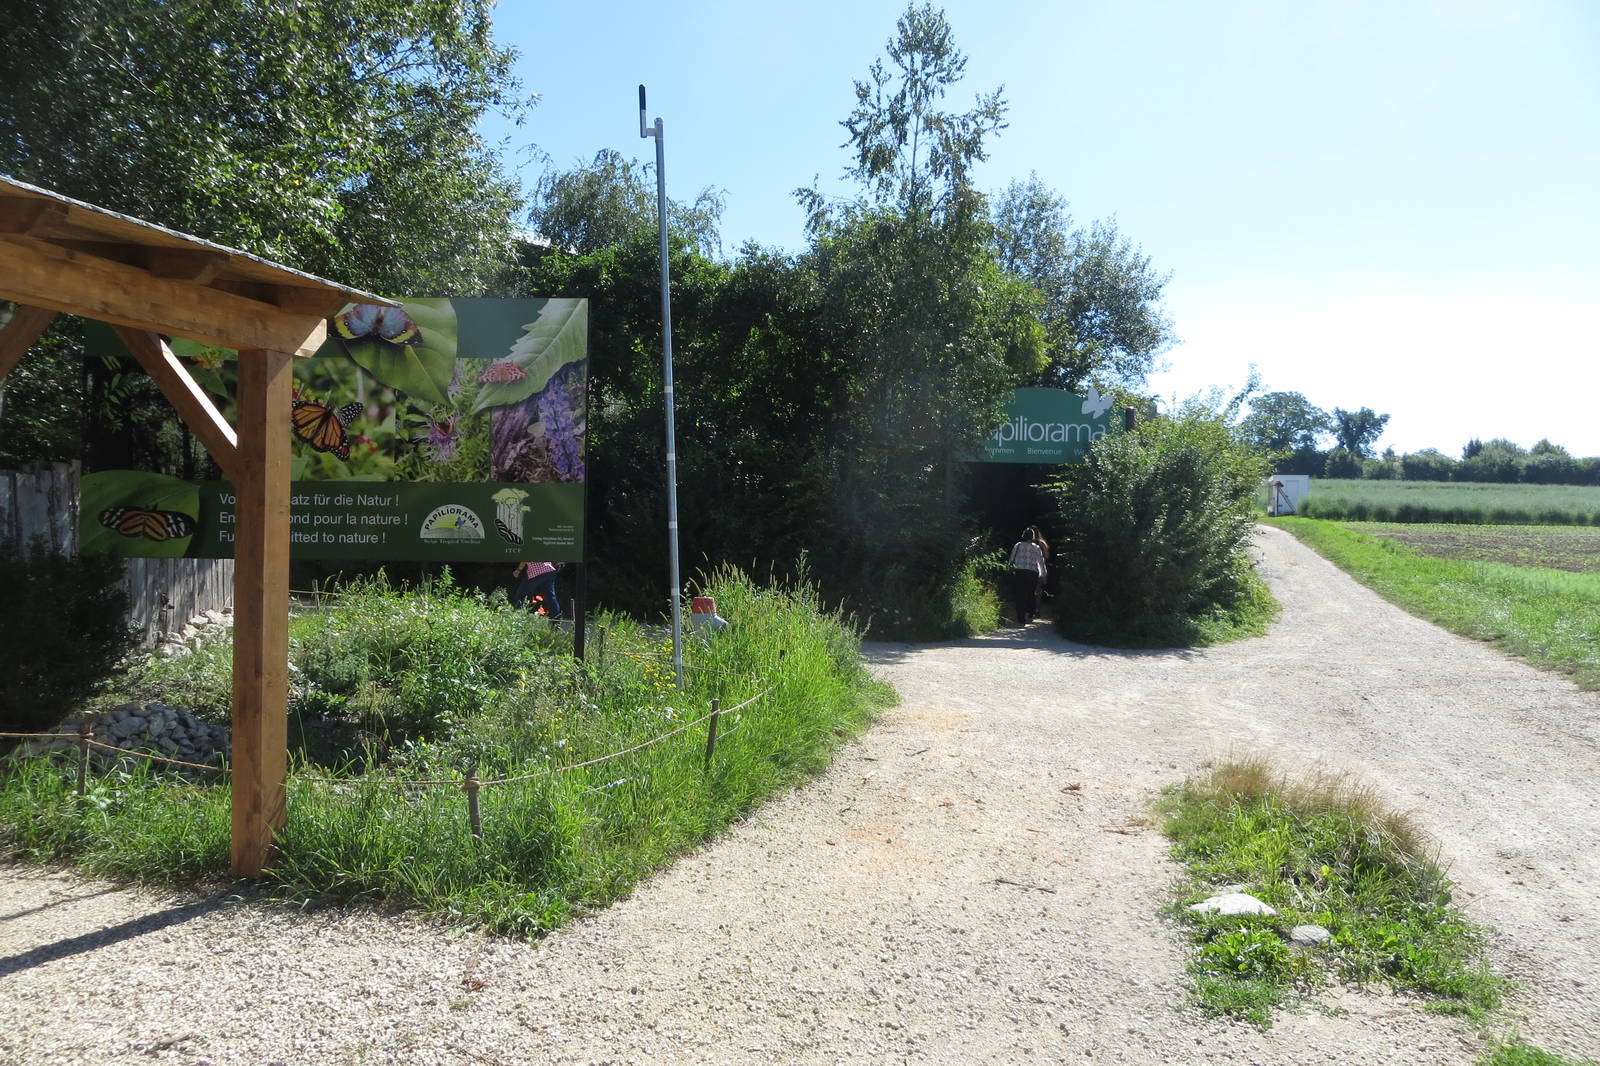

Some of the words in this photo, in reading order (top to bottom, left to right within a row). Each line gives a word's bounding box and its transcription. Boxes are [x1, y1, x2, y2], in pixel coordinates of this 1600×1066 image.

[985, 416, 1107, 447] apiliorama
[1027, 447, 1063, 455] Bienvenue
[314, 494, 330, 505] für
[334, 494, 353, 505] die
[357, 494, 392, 506] Natur
[288, 513, 310, 524] ond
[314, 515, 343, 526] pour
[347, 513, 357, 525] la
[361, 514, 401, 525] nature
[424, 507, 479, 530] PAPILIORAMA
[322, 532, 335, 543] to
[339, 532, 379, 543] nature
